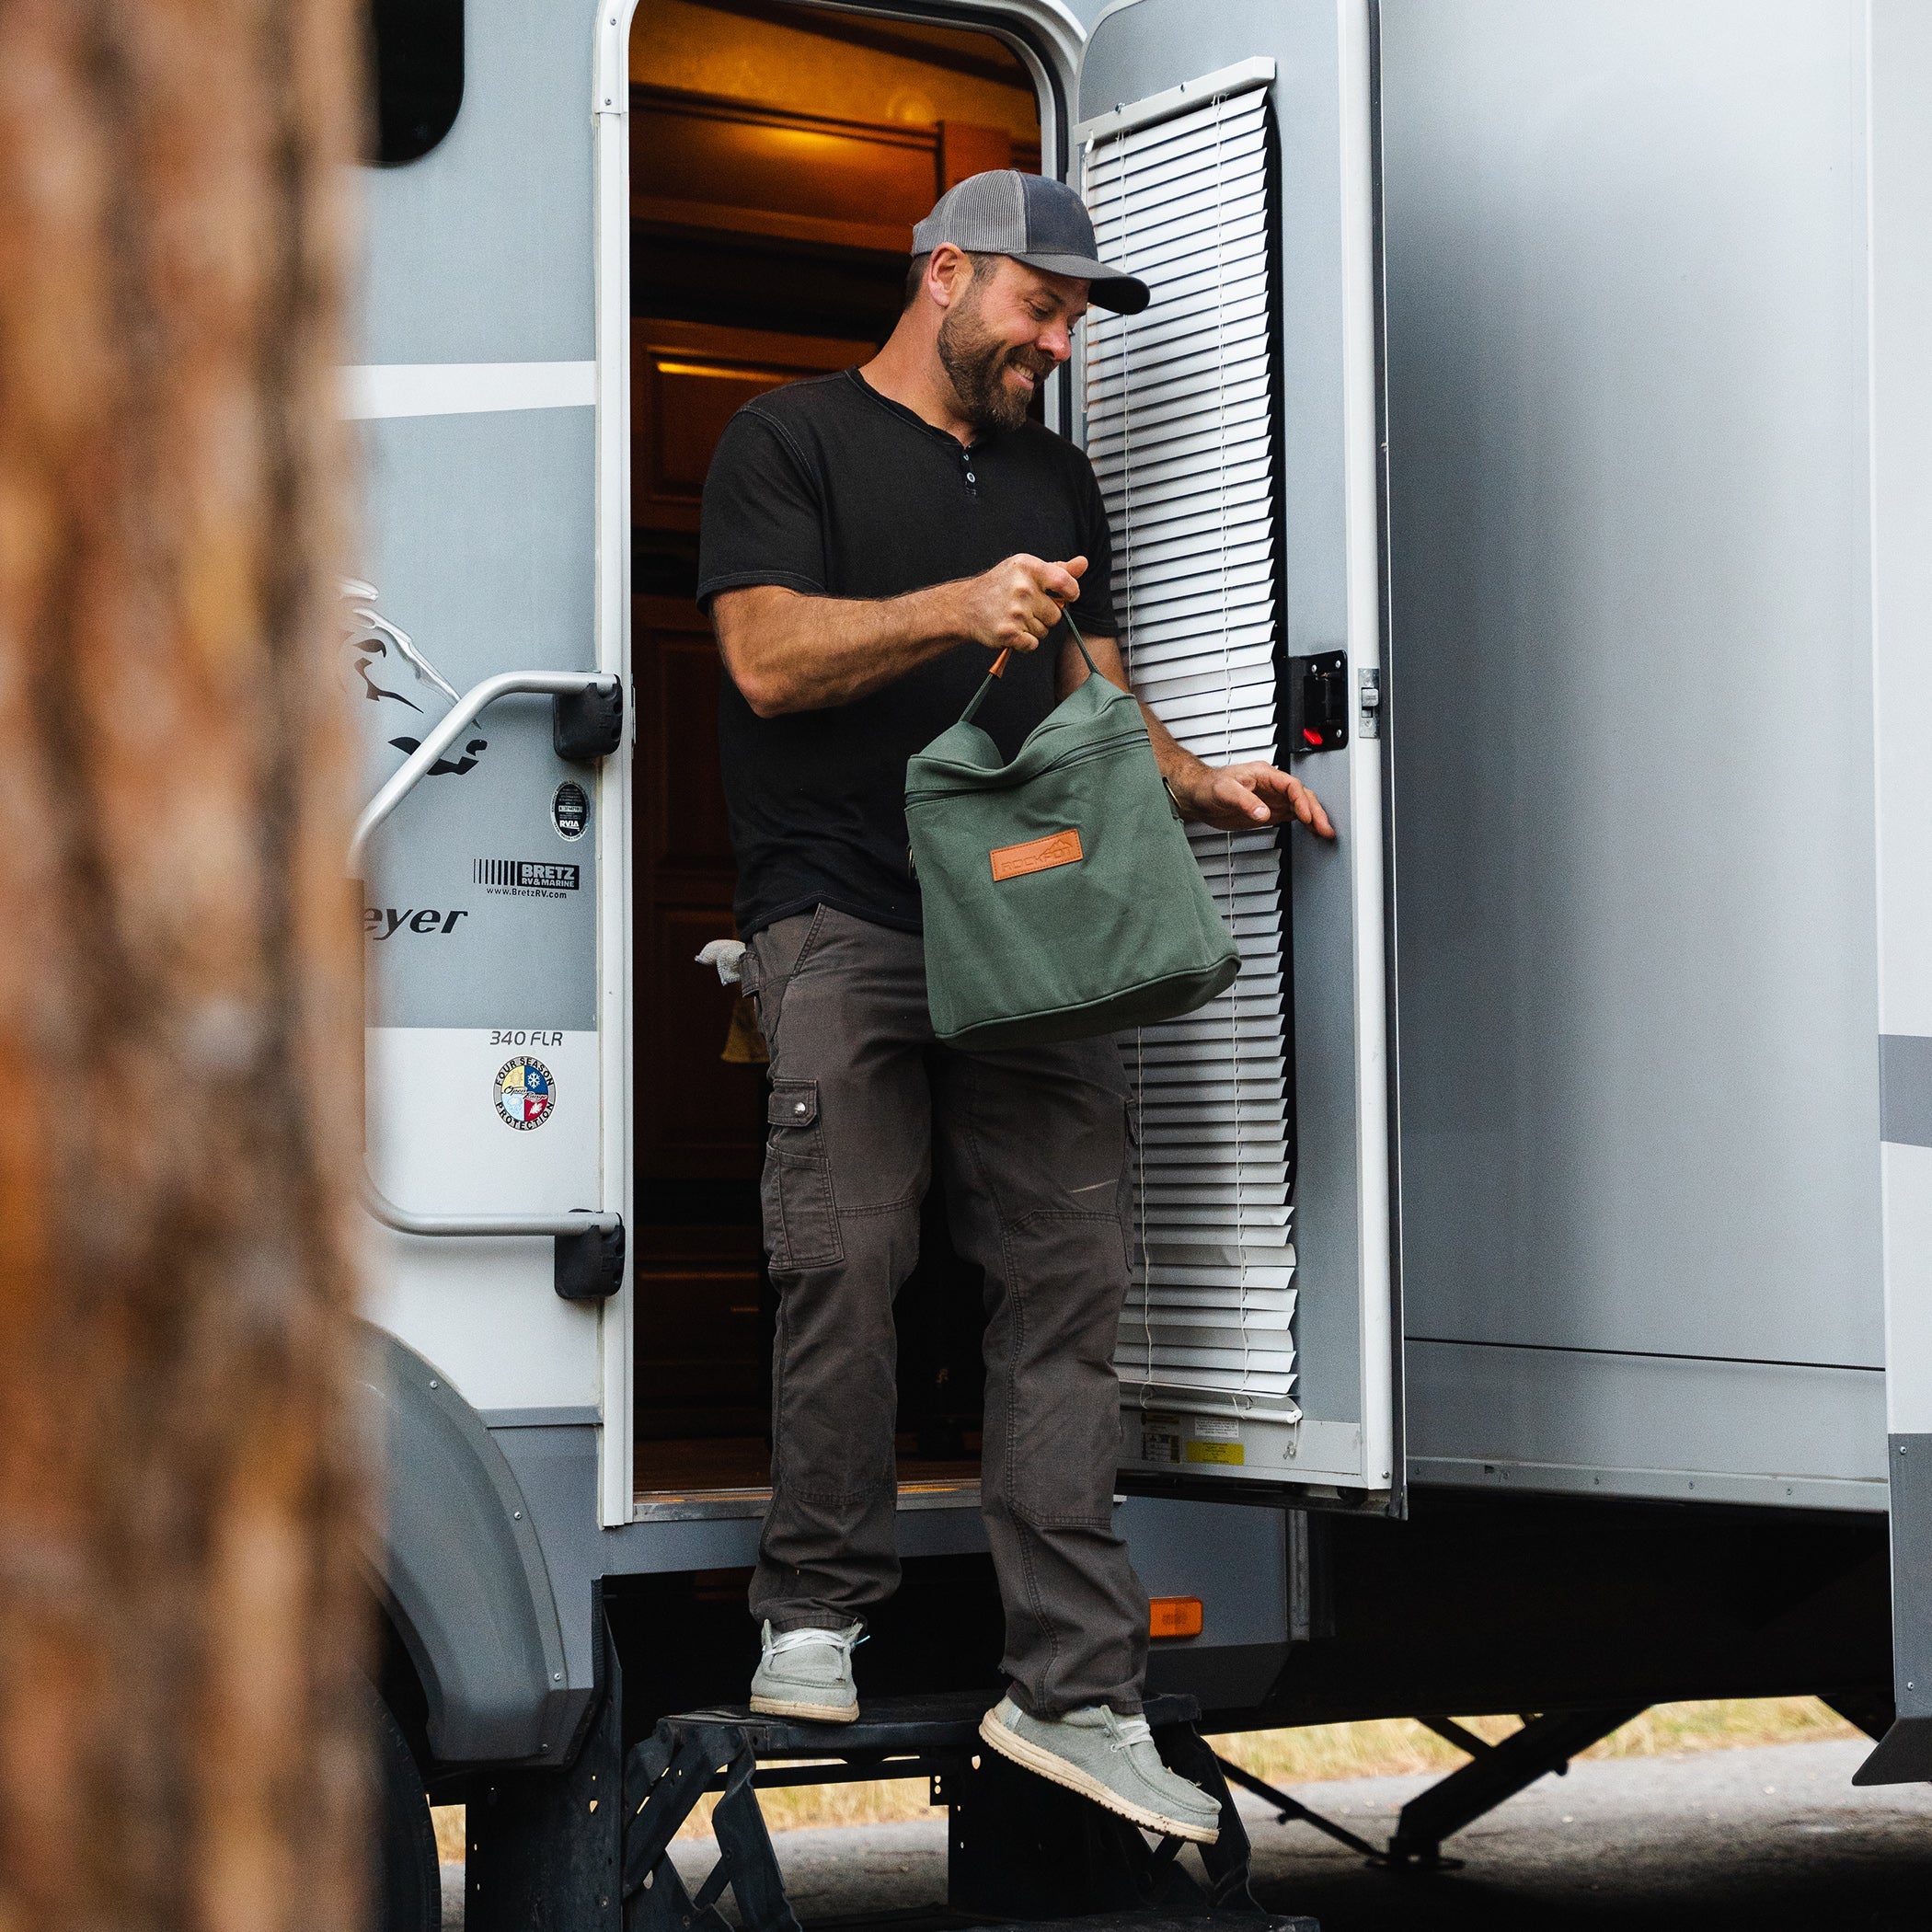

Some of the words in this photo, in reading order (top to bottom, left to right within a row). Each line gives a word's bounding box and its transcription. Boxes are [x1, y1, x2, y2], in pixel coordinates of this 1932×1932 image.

[559, 820, 580, 828] RVIA
[1001, 848, 1070, 871] ROCKPOT
[522, 864, 574, 880] BRETZ
[487, 888, 567, 899] www.BretzRV.com
[489, 1030, 526, 1046] 340
[530, 1031, 562, 1046] FLR
[496, 1060, 517, 1086] FOUR
[520, 1057, 554, 1086] SEASON
[496, 1102, 554, 1130] PROTECTION
